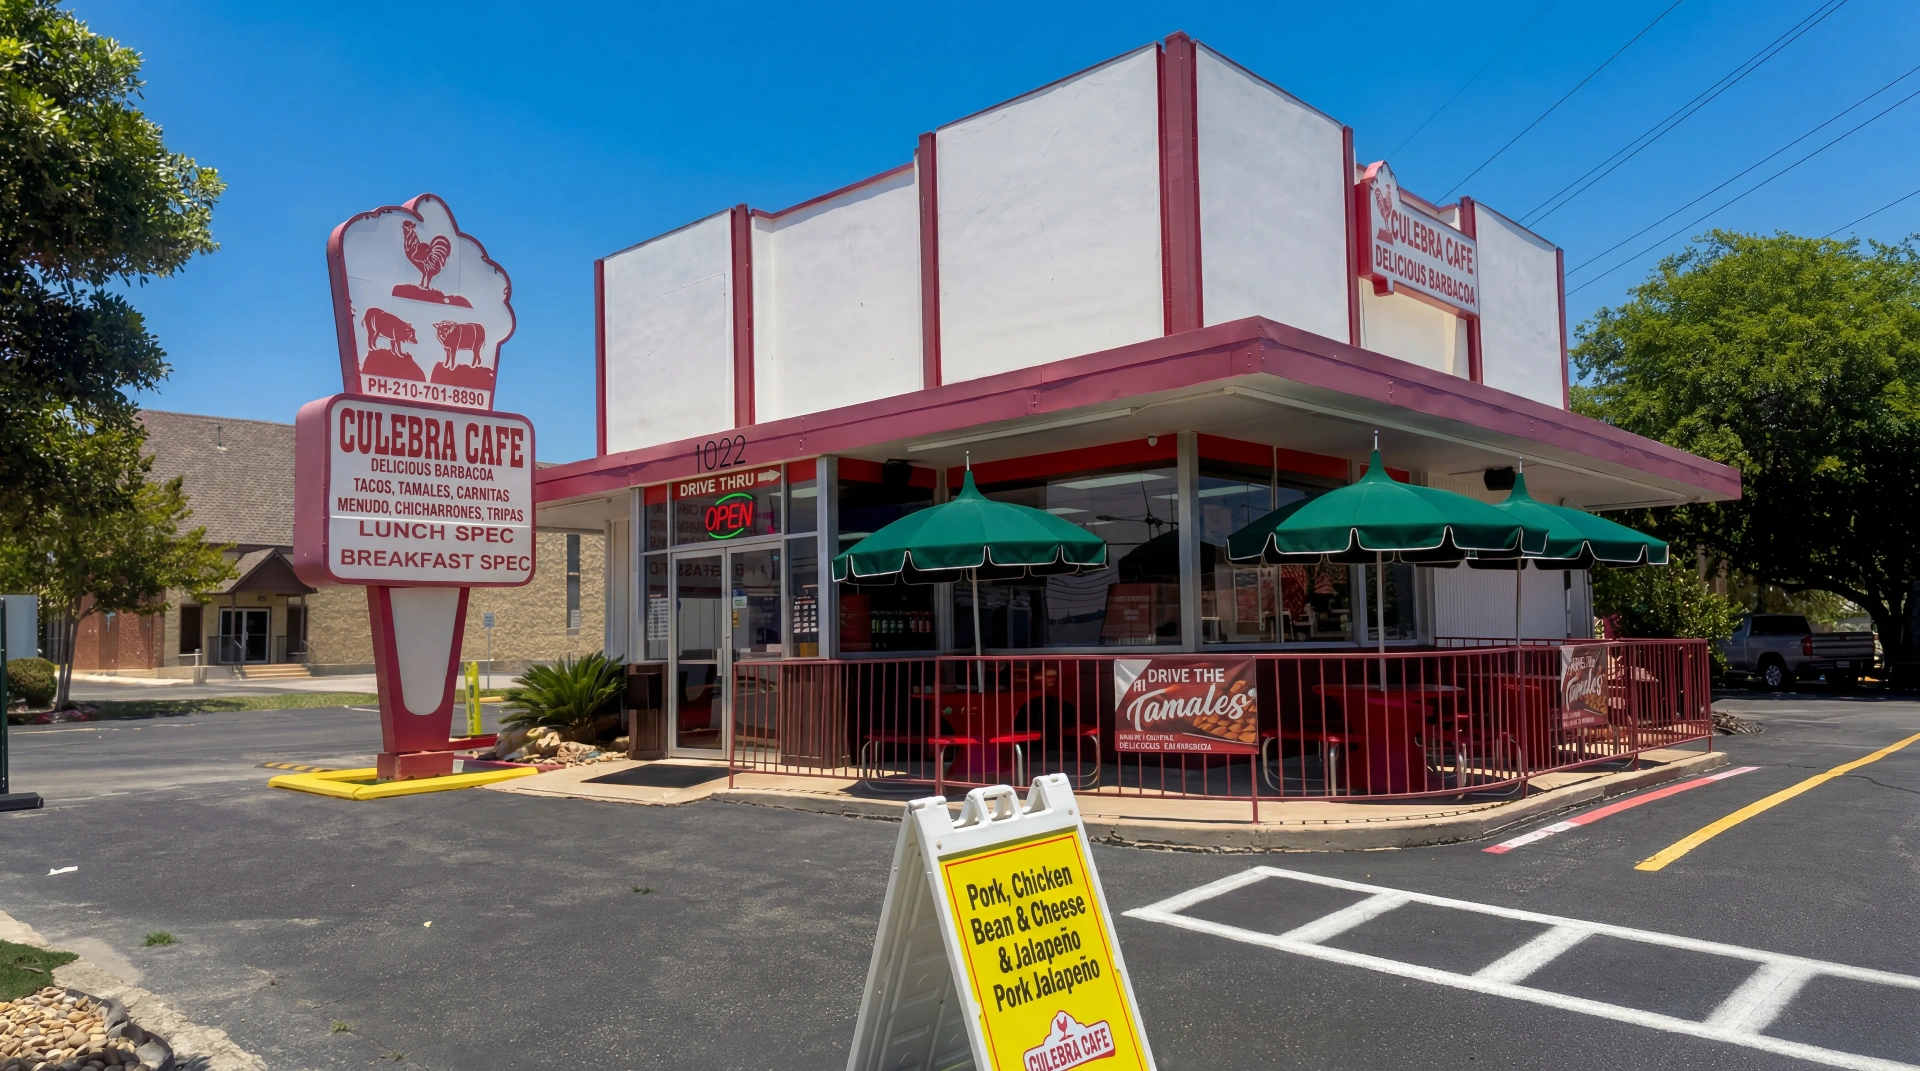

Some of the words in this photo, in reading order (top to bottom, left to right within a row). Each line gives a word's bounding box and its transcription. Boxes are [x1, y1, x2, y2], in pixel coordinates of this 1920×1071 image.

[1391, 209, 1443, 261] CULEBRA
[1446, 237, 1473, 275] CAFE
[1376, 244, 1426, 286] DELICIOUS
[1429, 268, 1475, 307] BARBACOA
[368, 378, 484, 406] PH-210-701-8890
[340, 408, 457, 462] CULEBRA
[465, 423, 524, 468] CAFE
[695, 435, 746, 473] 1022
[371, 458, 431, 477] DELICIOUS
[435, 464, 494, 482] BARBACOA
[680, 479, 715, 497] DRIVE
[719, 473, 754, 490] THRU
[354, 478, 395, 496] TACOS,
[398, 481, 454, 501] TAMALES,
[457, 486, 509, 502] CARNITAS
[338, 497, 392, 516] MENUDO,
[395, 501, 485, 522] CHICHARRONES,
[487, 507, 524, 522] TRIPAS
[705, 501, 753, 531] OPEN
[359, 520, 445, 540] LUNCH
[455, 526, 514, 544] SPEC
[341, 549, 474, 570] BREAKFAST
[480, 554, 530, 571] SPEC
[1148, 669, 1190, 683] DRIVE
[1194, 668, 1225, 683] THE
[1126, 682, 1252, 732] Tamales
[966, 878, 1011, 911] Pork,
[1011, 866, 1073, 899] Chicken
[970, 914, 1014, 945] Bean
[1016, 905, 1030, 932] &
[1030, 895, 1086, 928] Cheese
[998, 946, 1013, 974] &
[1014, 926, 1081, 969] Jalapeño
[993, 977, 1034, 1012] Pork
[1034, 955, 1100, 999] Jalapeño
[1028, 1039, 1082, 1071] CULEBRA
[1081, 1028, 1110, 1056] CAFE
